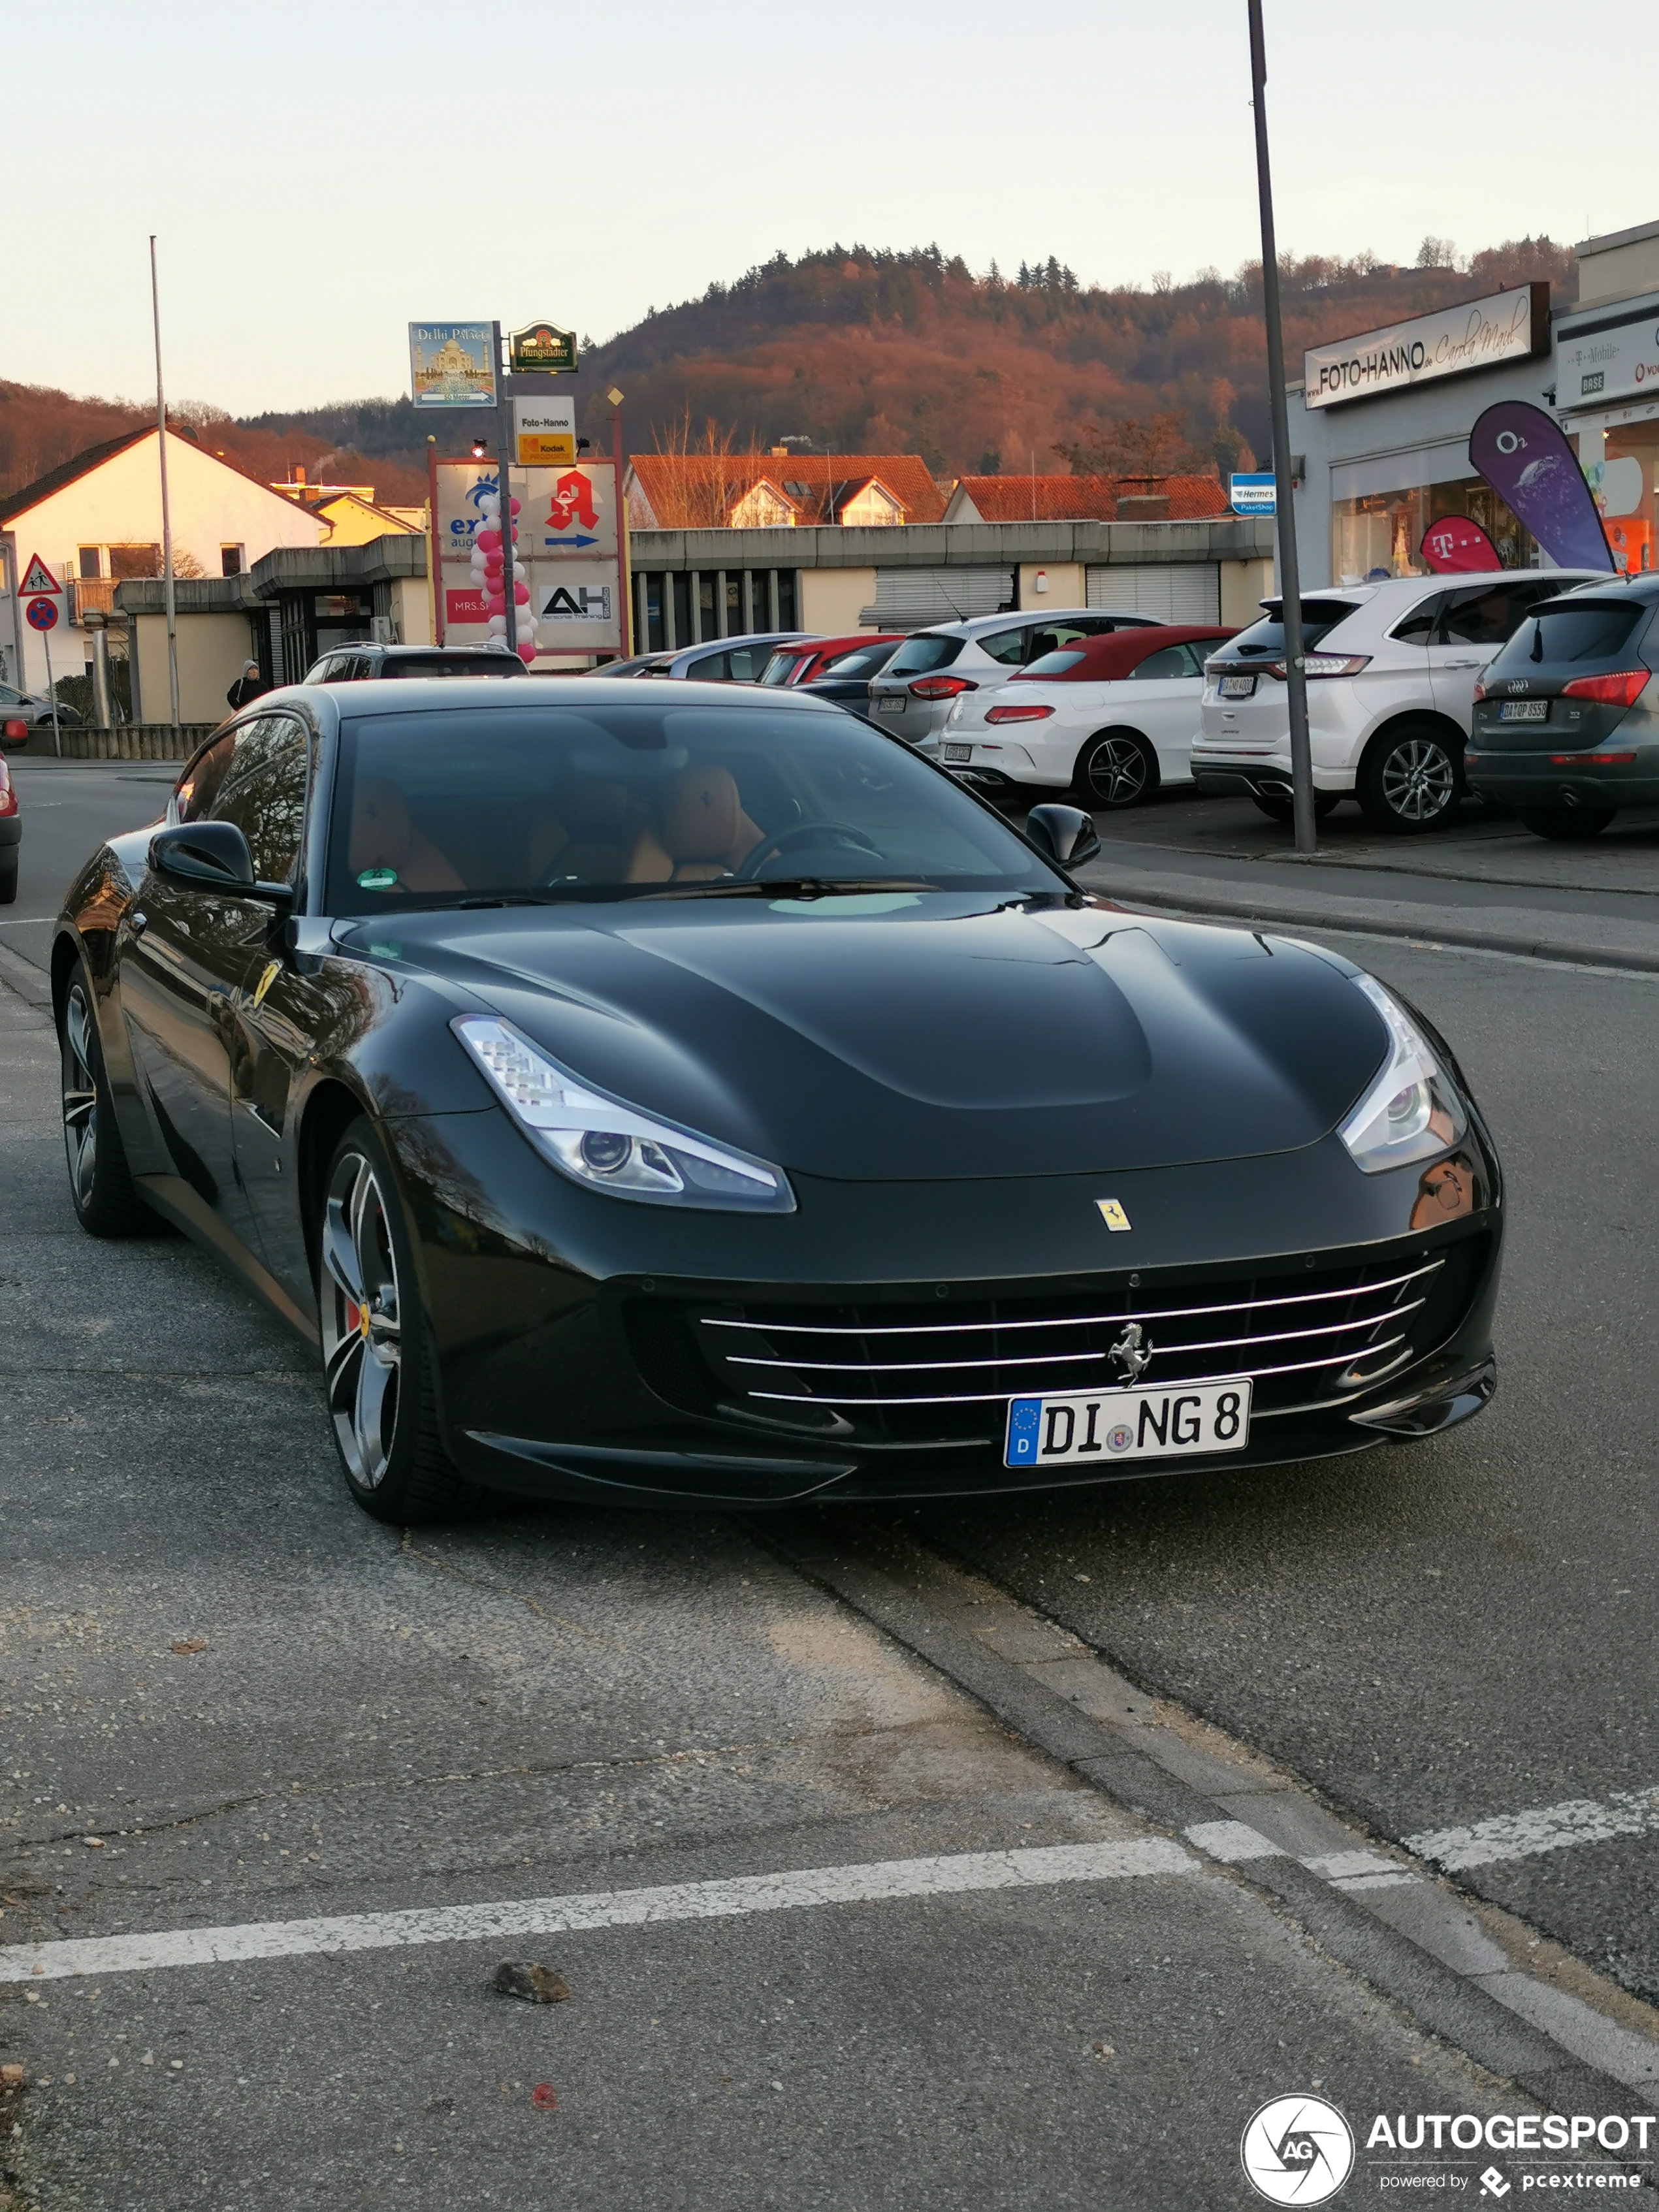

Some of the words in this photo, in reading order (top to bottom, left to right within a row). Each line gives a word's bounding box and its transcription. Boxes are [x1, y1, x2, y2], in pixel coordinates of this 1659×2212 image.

[418, 329, 447, 340] Delhi
[452, 329, 488, 340] Palace
[520, 347, 568, 360] Pfungstädter
[1583, 376, 1603, 392] BASE
[522, 419, 569, 427] Foto-Hanno
[1042, 1403, 1102, 1455] DI
[1137, 1396, 1201, 1448] NG
[1214, 1392, 1240, 1441] 8
